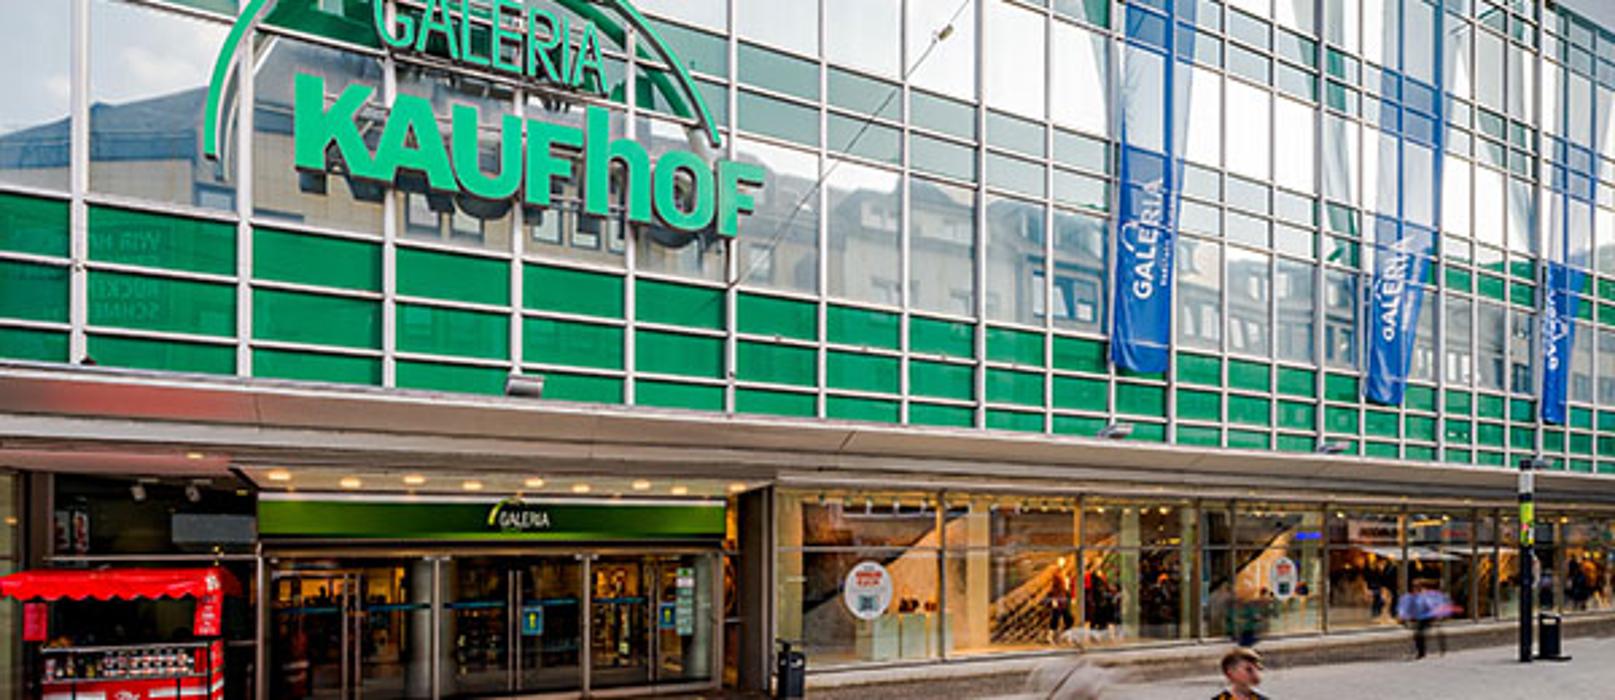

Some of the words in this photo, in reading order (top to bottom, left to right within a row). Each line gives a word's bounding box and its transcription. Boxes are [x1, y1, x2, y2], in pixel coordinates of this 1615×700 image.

[373, 0, 609, 98] GALERIA
[1132, 177, 1164, 300] GALERIA
[498, 510, 551, 528] GALERIA
